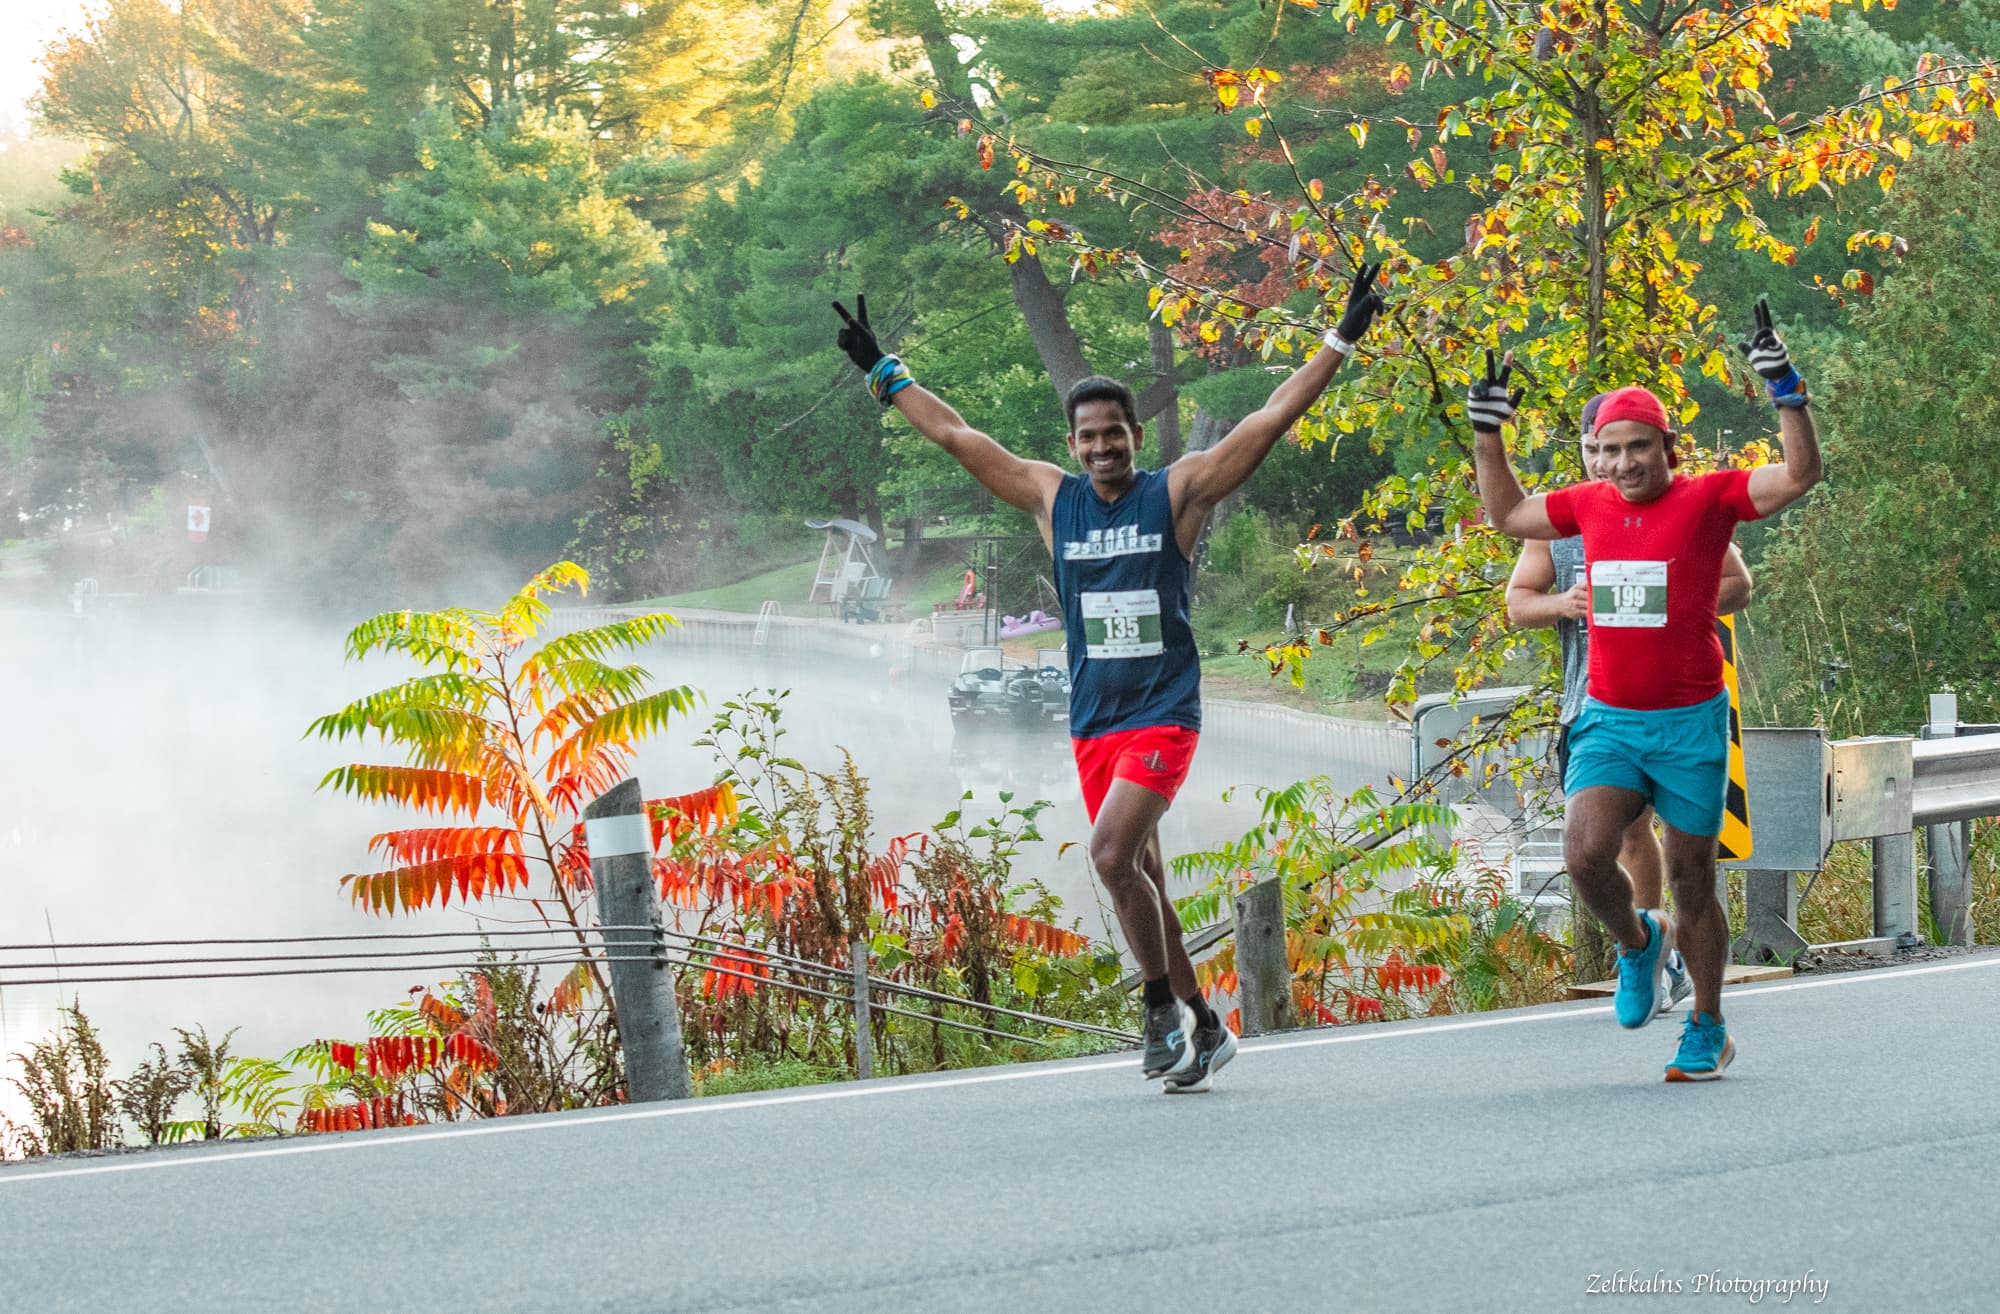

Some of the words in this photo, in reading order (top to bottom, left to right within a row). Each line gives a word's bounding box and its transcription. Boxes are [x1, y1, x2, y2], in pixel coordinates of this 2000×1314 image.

[1088, 524, 1139, 543] BACK
[1611, 586, 1646, 608] 199
[1103, 617, 1139, 638] 135
